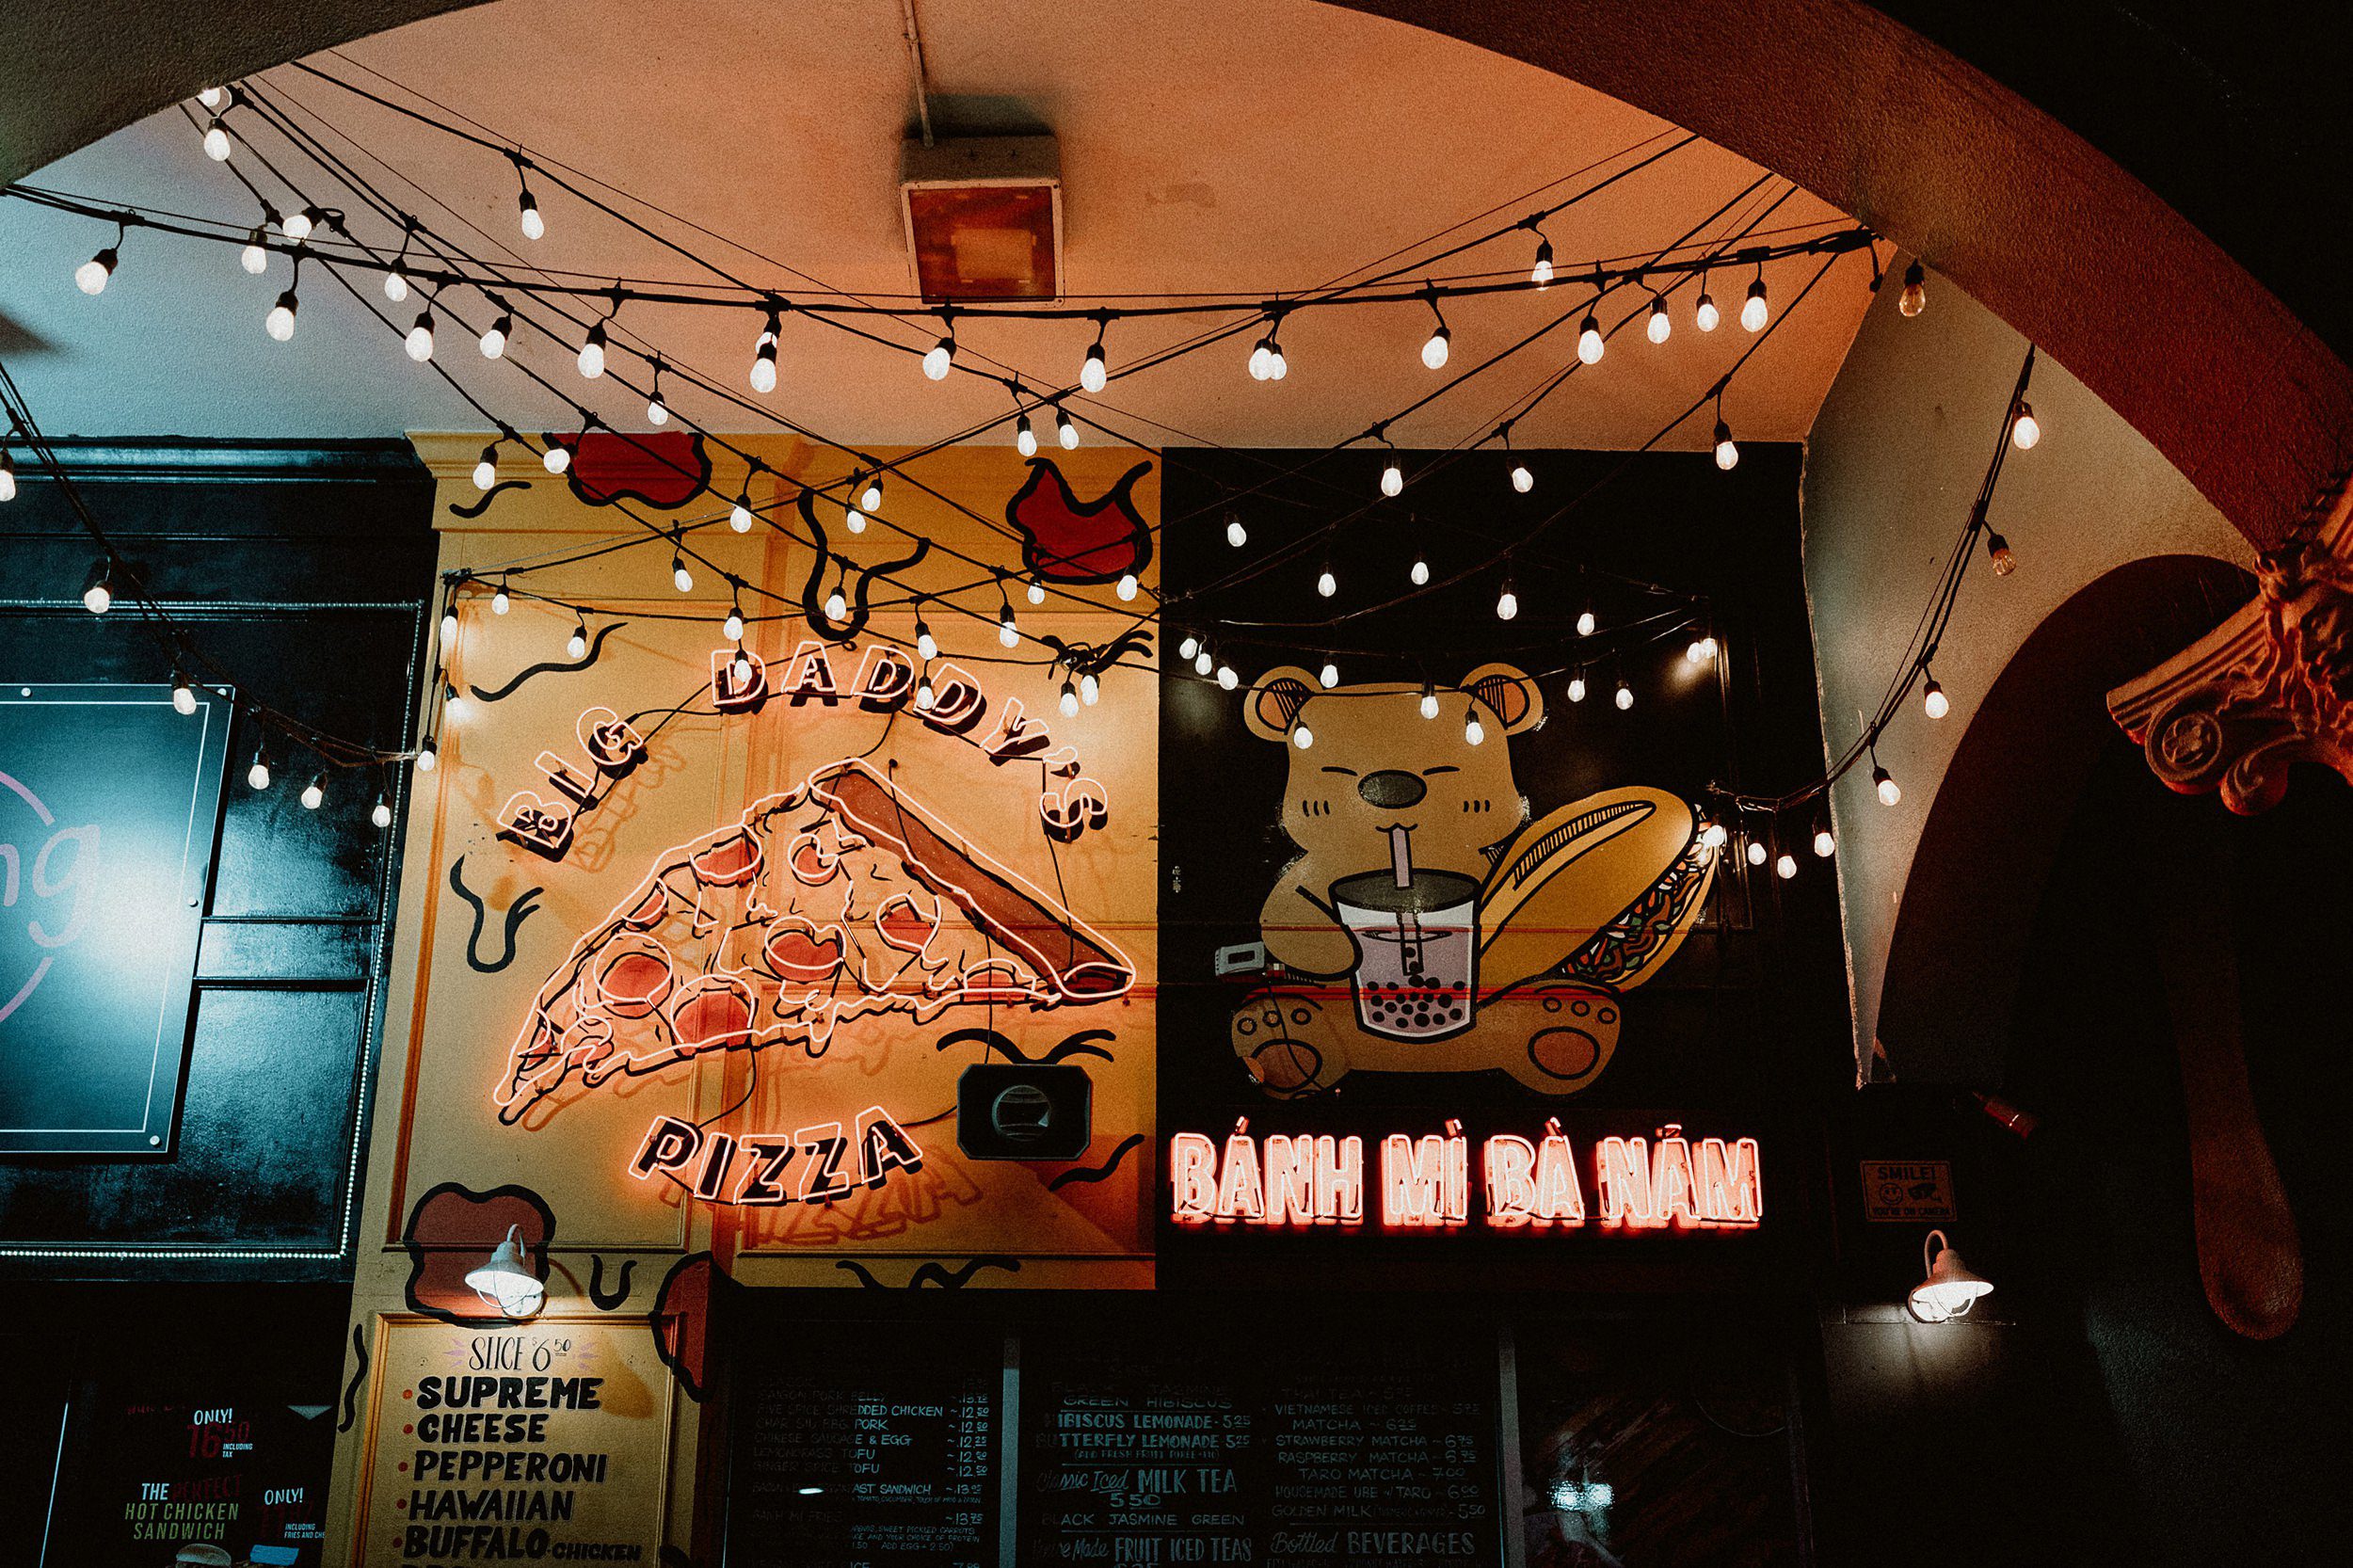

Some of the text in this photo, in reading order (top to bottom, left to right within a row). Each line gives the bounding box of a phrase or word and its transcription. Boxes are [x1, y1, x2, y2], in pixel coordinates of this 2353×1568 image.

[497, 641, 1109, 861] BIG DADDY'S
[628, 1105, 922, 1206] PIZZA
[469, 1336, 525, 1370] SLICE
[416, 1376, 604, 1410] SUPREME
[193, 1408, 232, 1426] ONLY!
[891, 1405, 943, 1417] CHICKEN
[416, 1414, 550, 1444] CHEESE
[855, 1418, 889, 1431] PORK
[1133, 1413, 1213, 1430] LEMONADE
[1292, 1419, 1362, 1432] MATCHA
[881, 1434, 912, 1446] EGG
[1142, 1432, 1220, 1448] LEMONADE
[1275, 1434, 1365, 1447] STRAWBERRY
[1371, 1435, 1428, 1447] MATCHA
[413, 1449, 608, 1483] PEPPERONI
[1278, 1451, 1358, 1464] RASPBERRY
[1369, 1451, 1430, 1464] MATCHA
[1138, 1469, 1187, 1494] MILK
[1197, 1469, 1238, 1493] TEA
[1299, 1467, 1341, 1480] TARO
[1348, 1468, 1414, 1480] MATCHA
[141, 1483, 169, 1500] THE
[264, 1487, 304, 1506] ONLY!
[879, 1484, 931, 1495] SANDWICH
[1397, 1486, 1432, 1499] TARO
[124, 1503, 159, 1520] HOT
[164, 1503, 239, 1520] CHICKEN
[408, 1490, 575, 1521] HAWAIIAN
[1333, 1505, 1372, 1518] MILK
[1108, 1513, 1178, 1527] JASMINE
[1192, 1513, 1245, 1527] GREEN
[134, 1522, 225, 1540] SANDWICH
[403, 1525, 642, 1561] BUFFALO CHICKEN
[1114, 1537, 1163, 1562] FRUIT
[1170, 1538, 1205, 1562] ICED
[1209, 1537, 1253, 1562] TEAS
[1271, 1531, 1475, 1555] Bottled BEVERAGES
